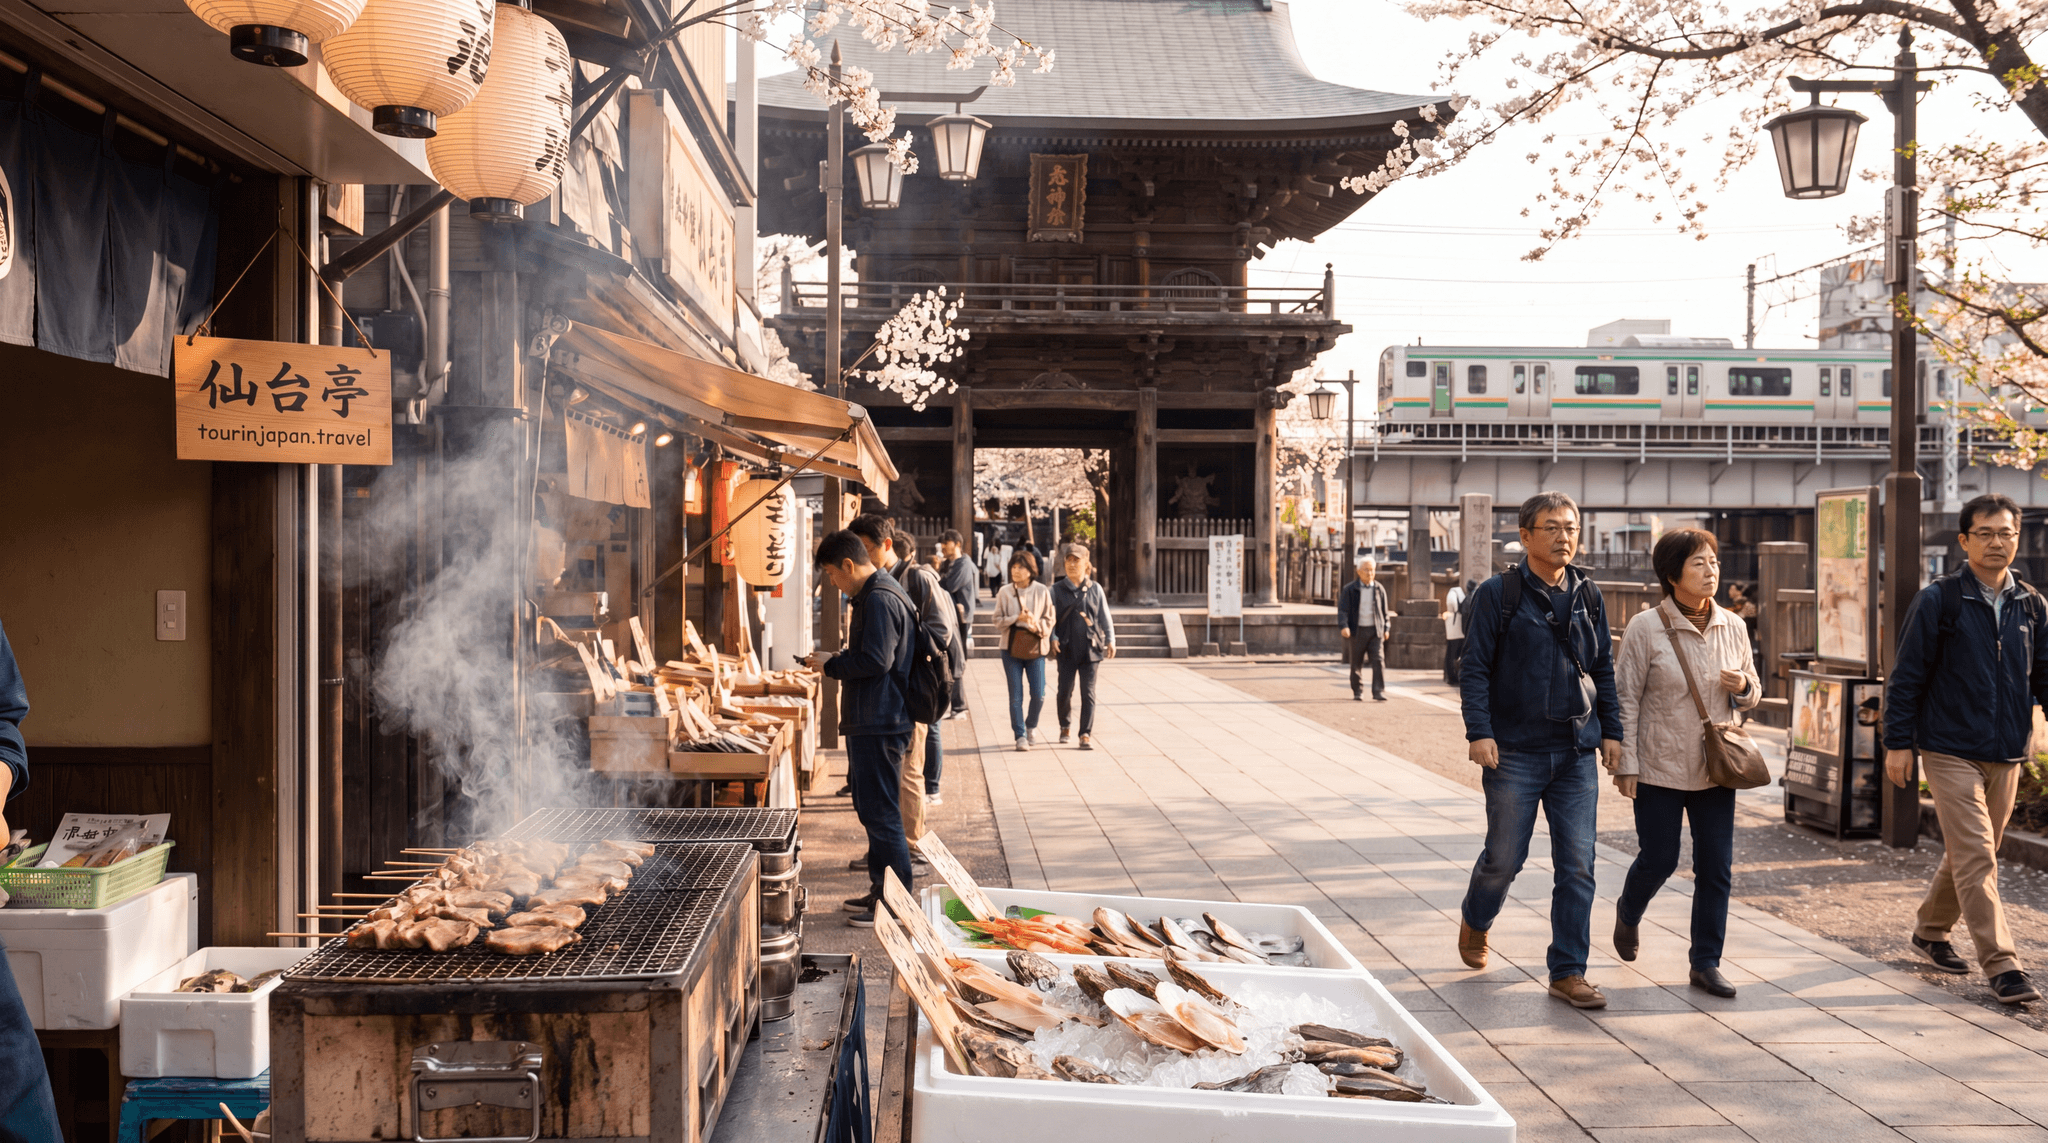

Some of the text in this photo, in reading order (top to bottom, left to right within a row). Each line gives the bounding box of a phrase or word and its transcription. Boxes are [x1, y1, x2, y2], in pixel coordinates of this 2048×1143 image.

[199, 359, 369, 418] 仙台亭
[198, 423, 371, 448] tourinjapan.travel
